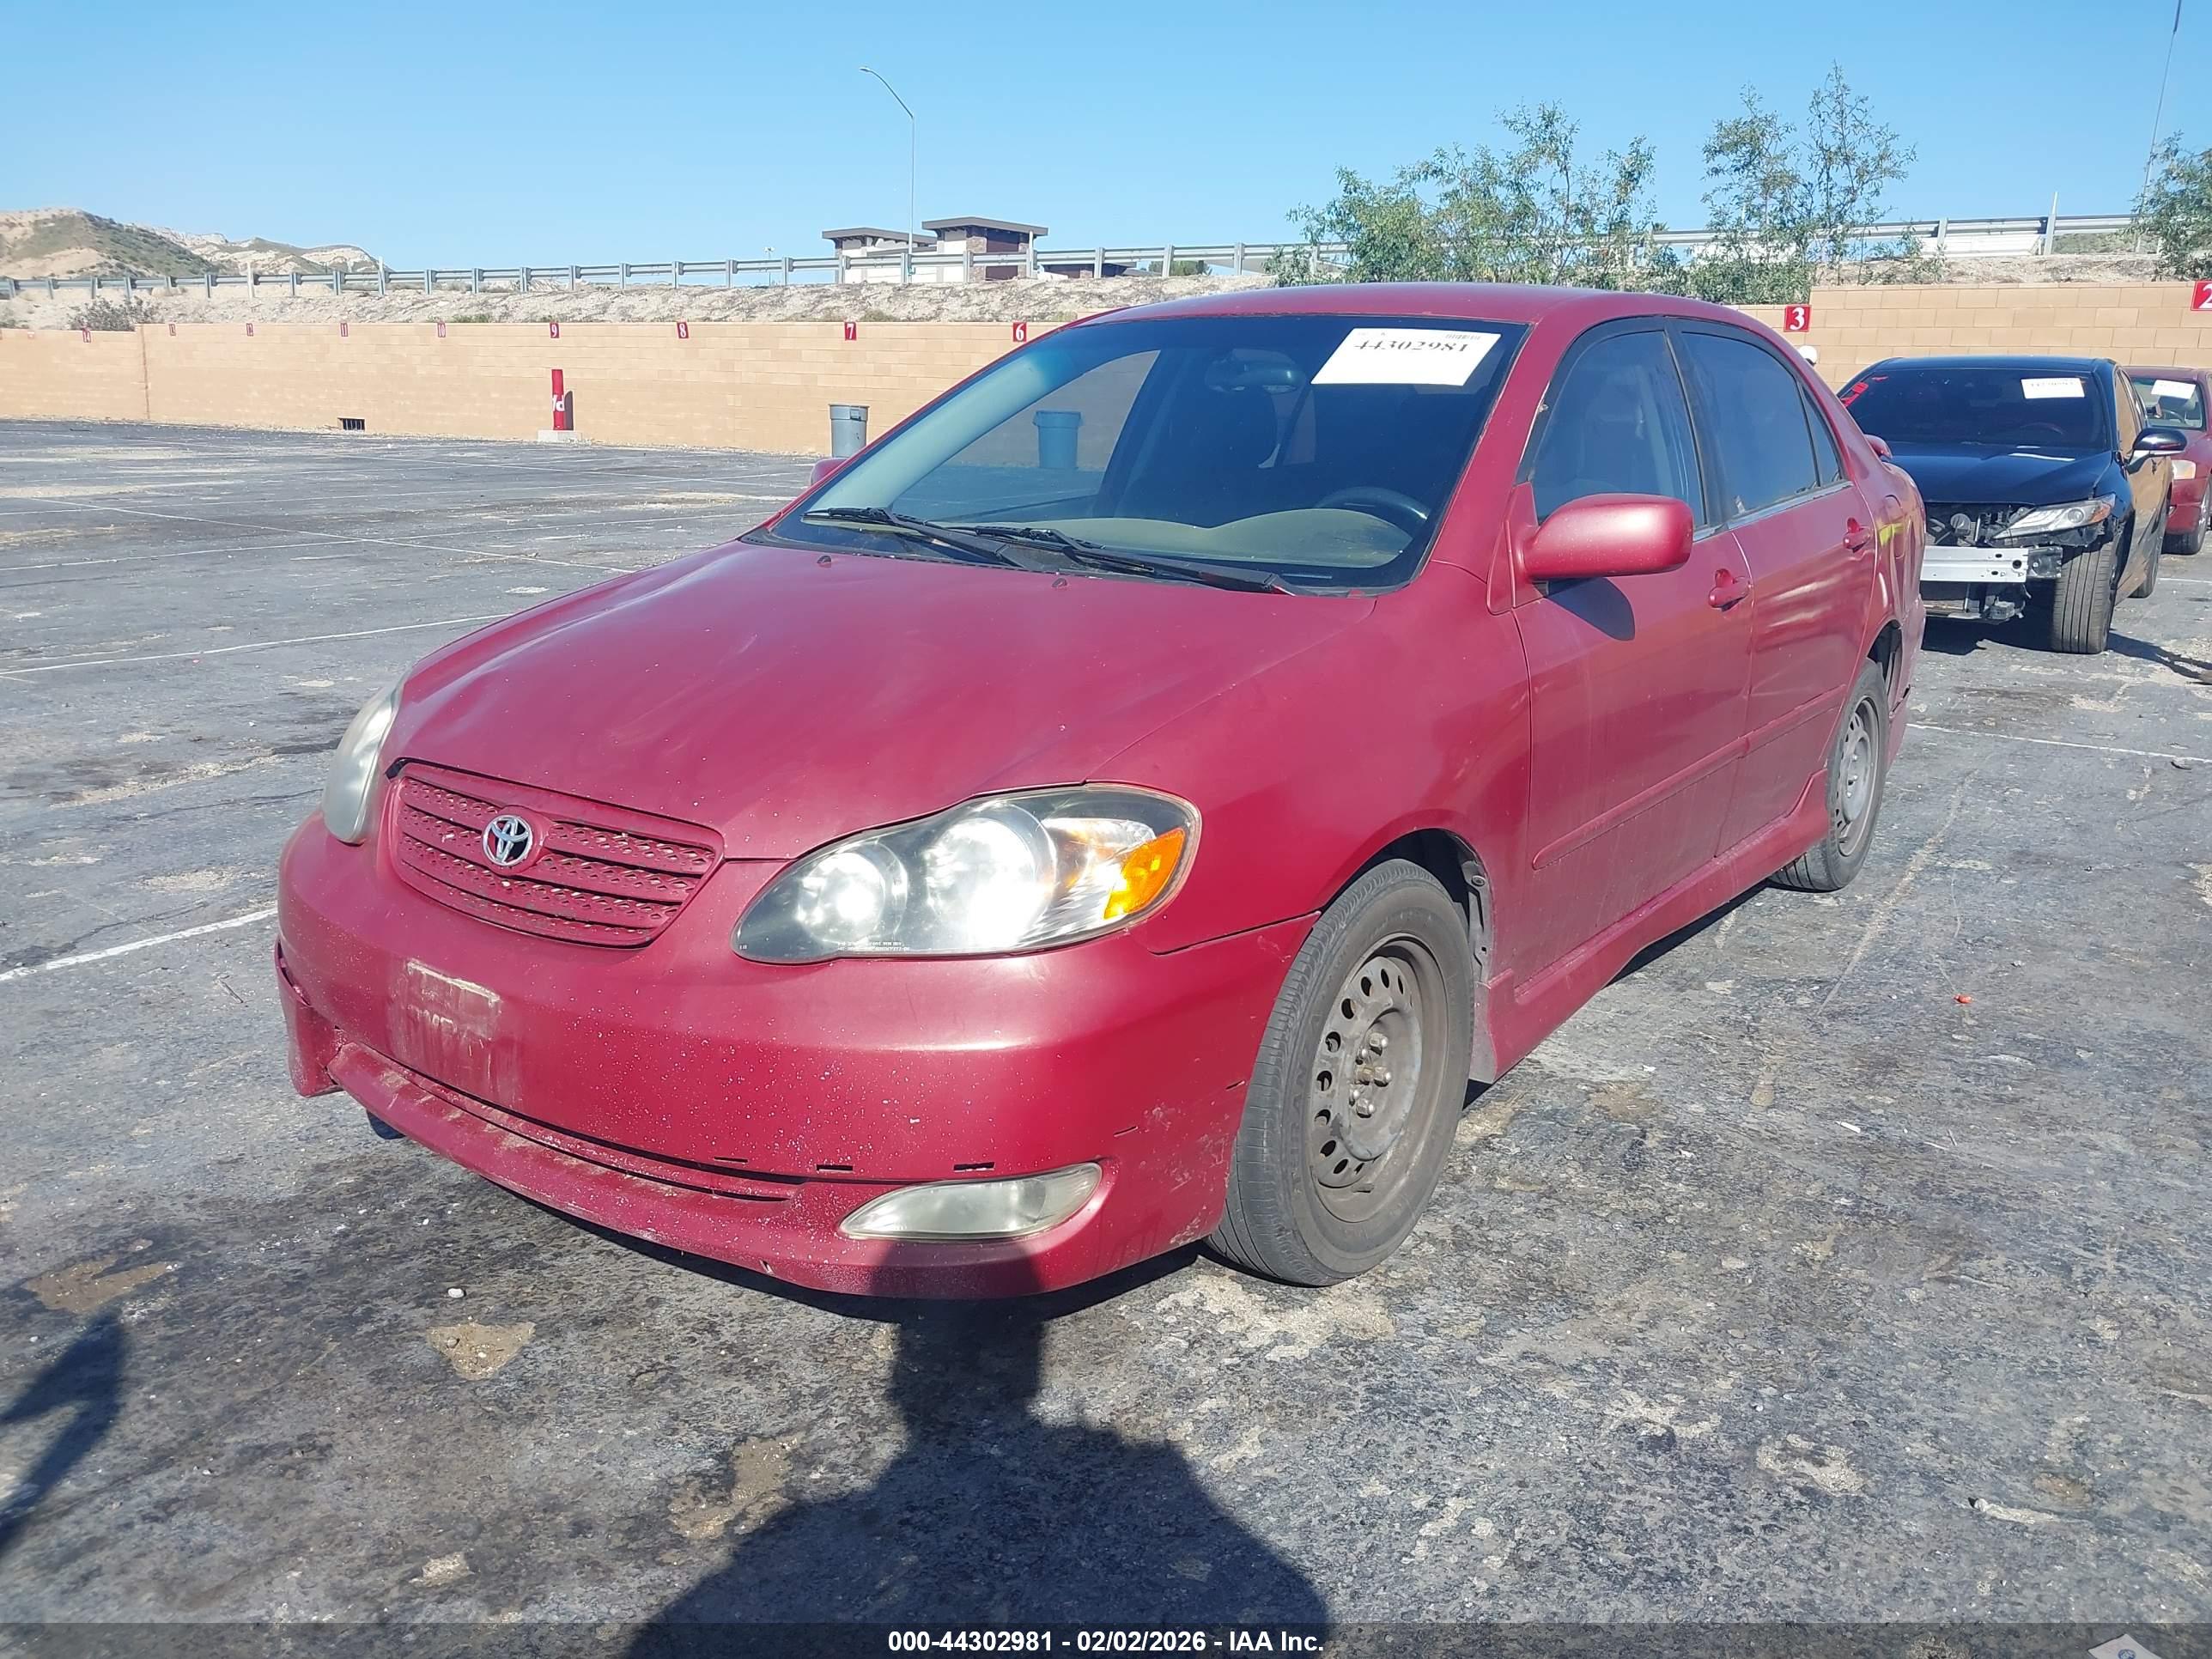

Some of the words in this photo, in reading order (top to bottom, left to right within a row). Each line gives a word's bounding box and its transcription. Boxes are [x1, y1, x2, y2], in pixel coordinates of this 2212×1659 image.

[2198, 283, 2212, 309] 2
[1790, 307, 1805, 331] 3
[678, 323, 686, 337] 8
[847, 323, 854, 338] 7
[1016, 323, 1024, 340] 6
[1354, 340, 1468, 351] 44302981
